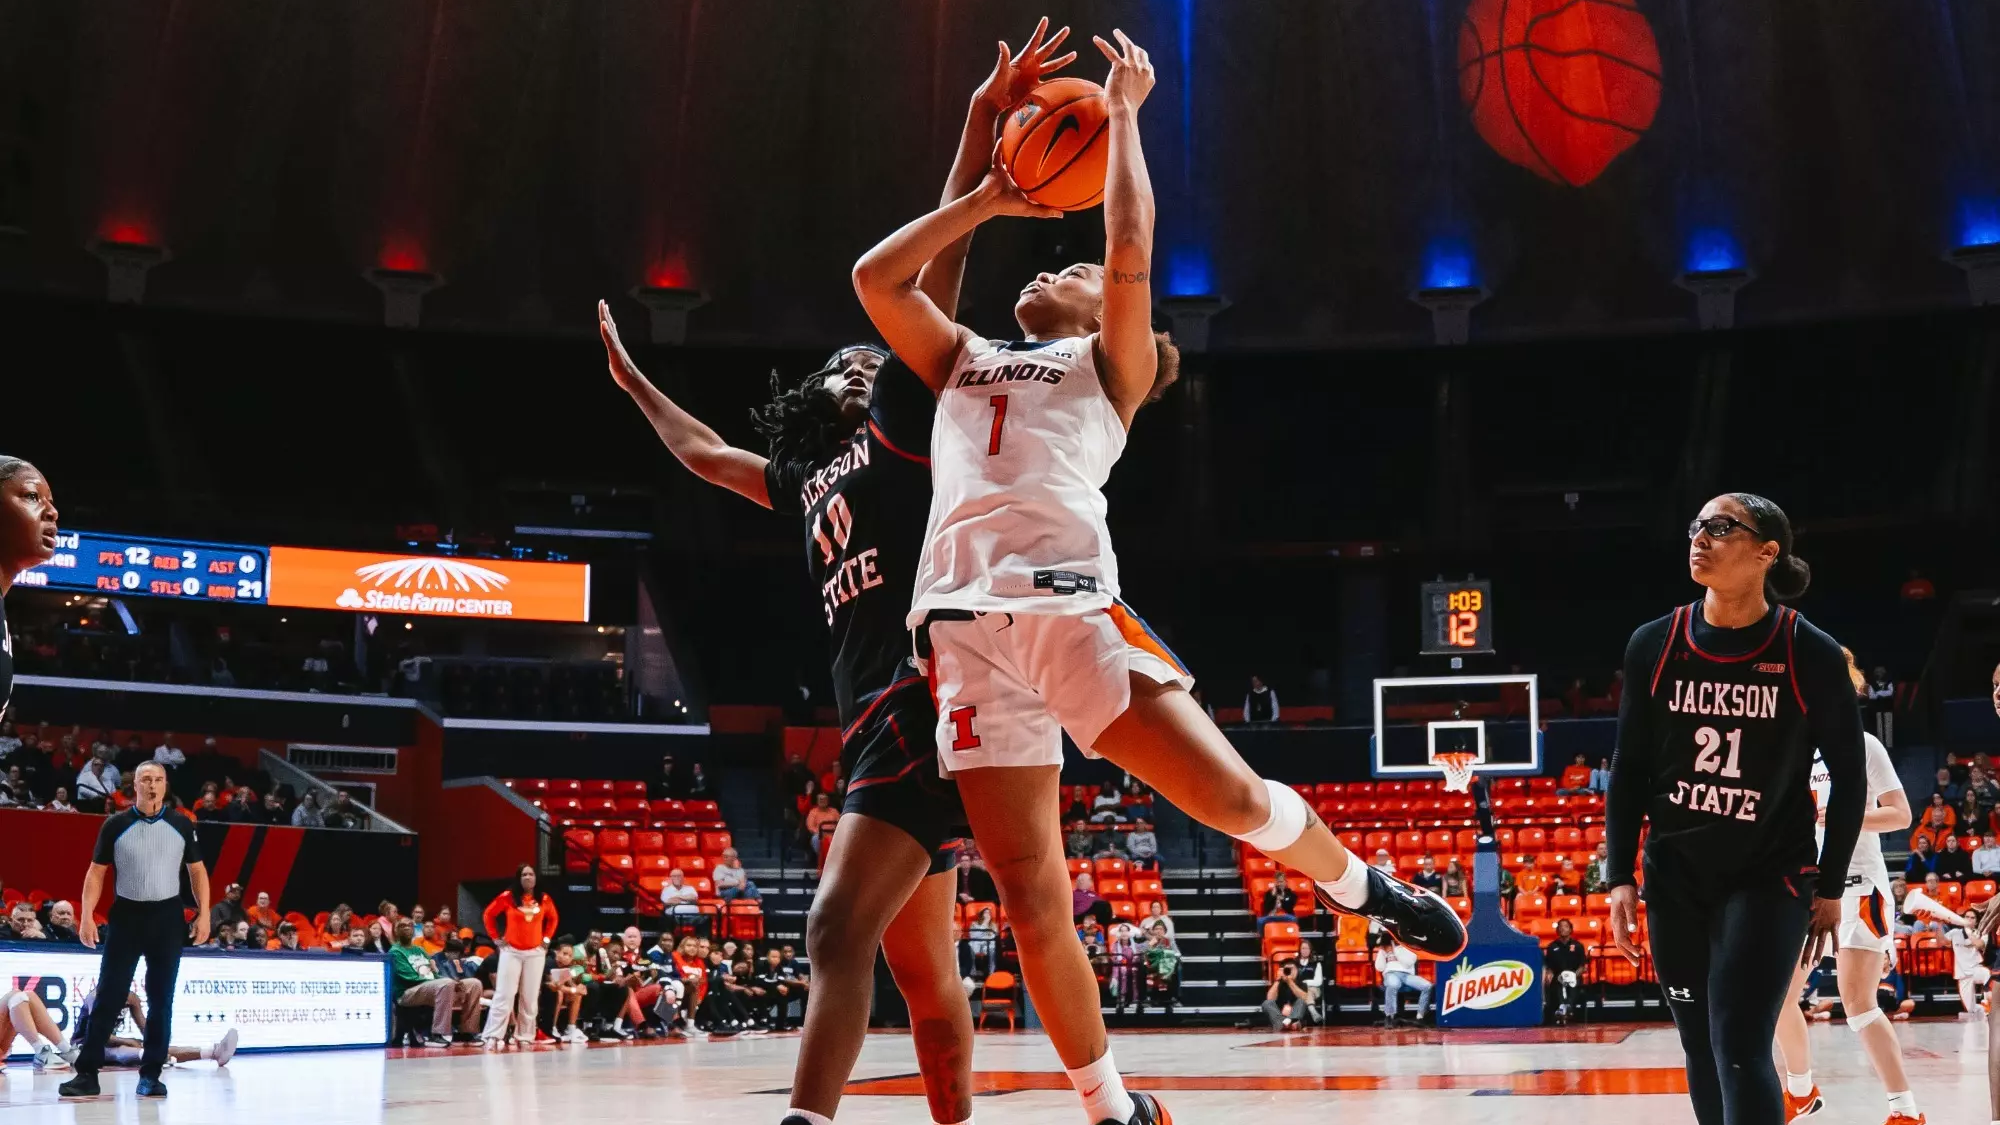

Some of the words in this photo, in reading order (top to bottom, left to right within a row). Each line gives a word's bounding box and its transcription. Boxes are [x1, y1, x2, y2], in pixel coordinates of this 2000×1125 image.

[956, 363, 1066, 389] ILLINOIS
[988, 394, 1008, 456] 1
[812, 493, 852, 565] 10
[99, 552, 123, 566] PTS
[125, 547, 150, 566] 12
[182, 551, 197, 569] 2
[209, 560, 236, 574] AST
[239, 555, 256, 573] 0
[122, 571, 140, 589] 0
[151, 581, 181, 595] STLS
[182, 577, 200, 595] 0
[237, 579, 262, 598] 21
[1449, 590, 1482, 611] 1:03
[455, 598, 512, 616] CENTER
[1450, 611, 1478, 647] 12
[1669, 679, 1779, 719] JACKSON
[949, 706, 981, 751] I
[1694, 726, 1742, 778] 21
[1669, 780, 1761, 821] STATE
[183, 979, 247, 994] ATTORNEYS
[252, 980, 296, 994] HELPING
[301, 981, 341, 996] INJURED
[345, 981, 379, 994] PEOPLE
[1445, 968, 1524, 1011] LIBMAN
